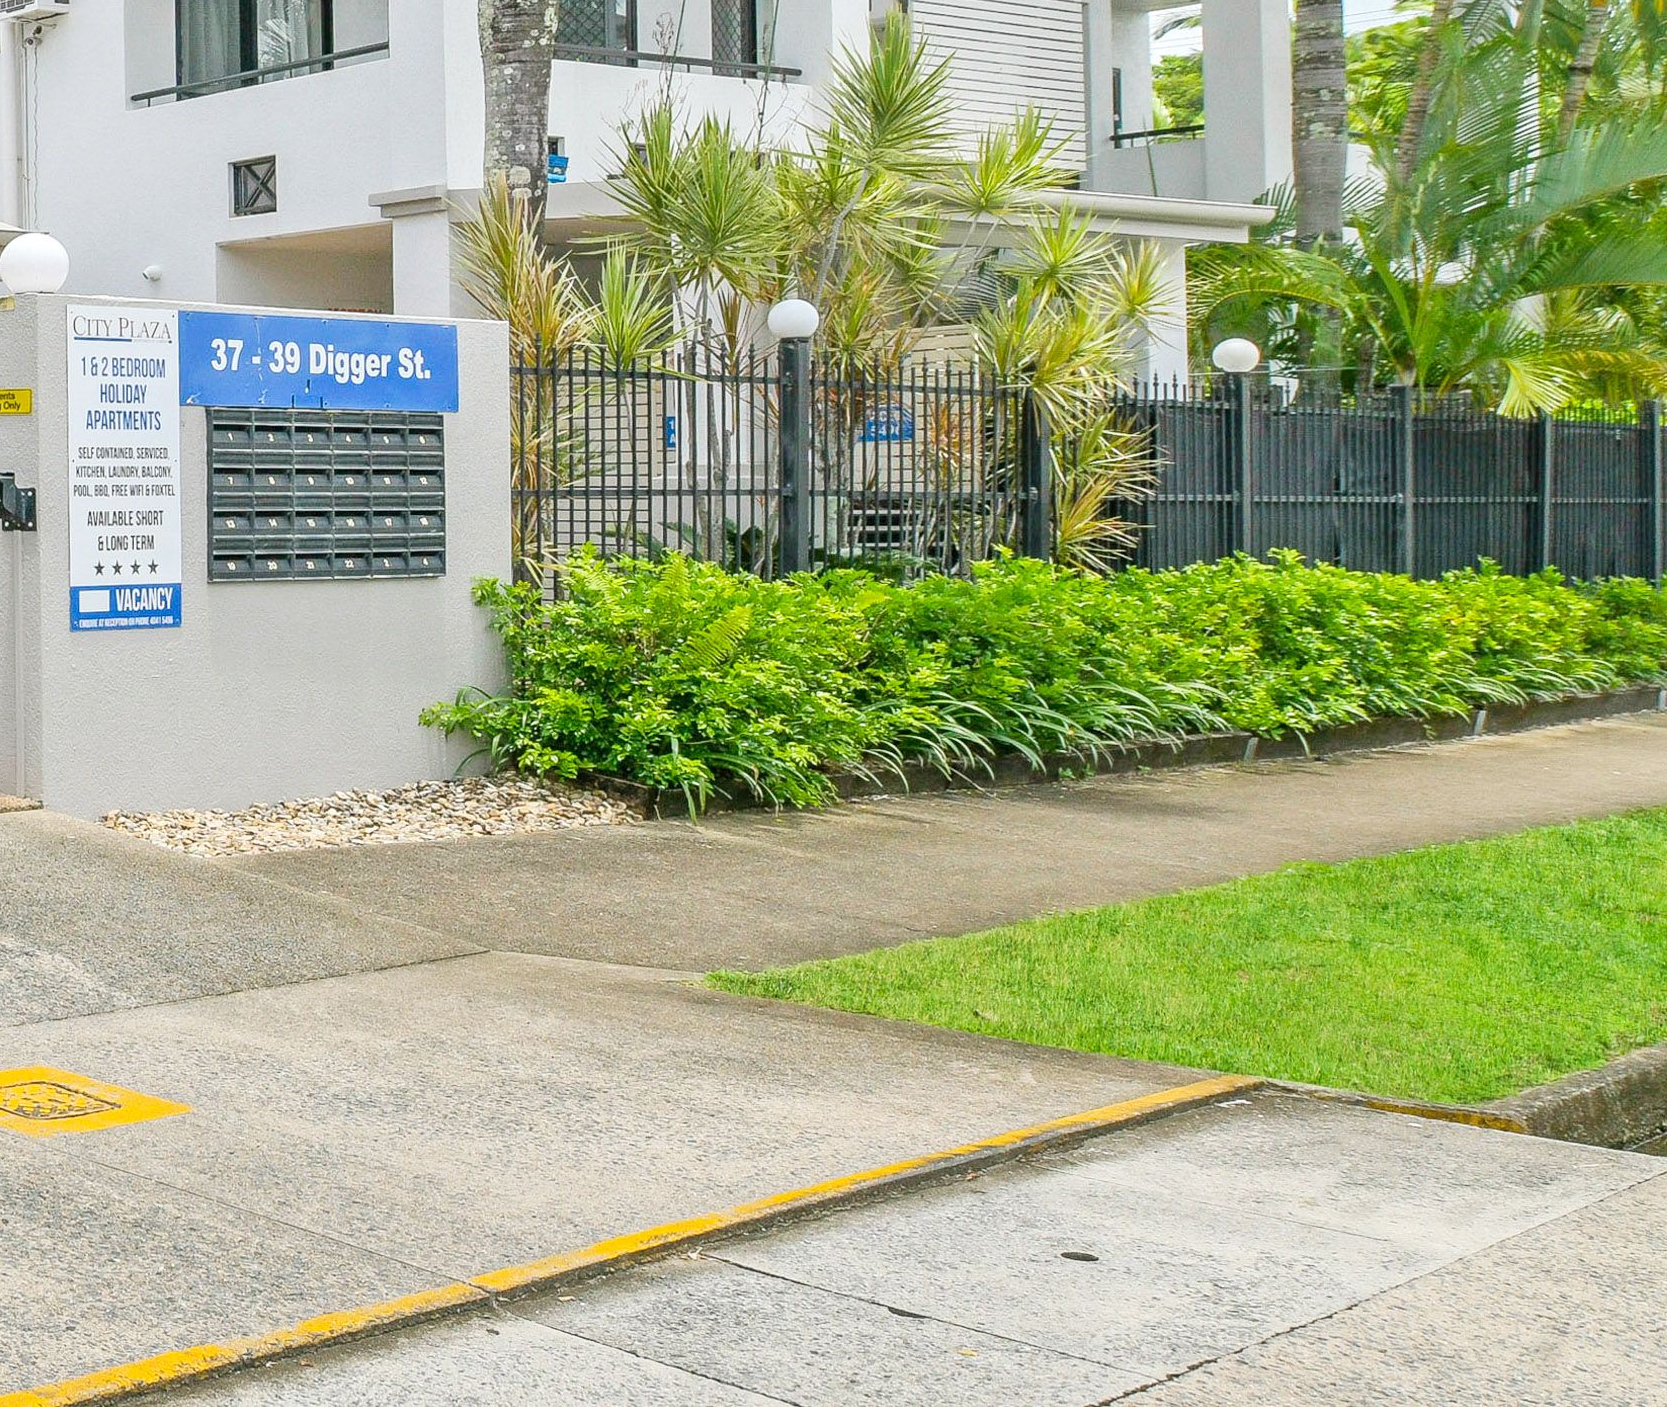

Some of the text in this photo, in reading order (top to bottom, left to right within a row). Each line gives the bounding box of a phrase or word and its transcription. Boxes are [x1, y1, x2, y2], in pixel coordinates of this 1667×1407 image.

[73, 315, 172, 340] CITY PLAZA
[210, 339, 431, 384] 37 - 39 Digger St.
[81, 356, 167, 379] 1 & 2 BEDROOM
[100, 383, 147, 404] HOLIDAY
[3, 401, 21, 411] Only
[86, 410, 162, 431] APARTMENTS
[227, 432, 235, 442] 1
[266, 434, 274, 443] 2
[306, 434, 314, 443] 3
[345, 434, 352, 443] 4
[78, 447, 95, 459] SELF
[227, 476, 234, 485] 7
[268, 476, 275, 485] 8
[308, 476, 315, 486] 9
[345, 477, 354, 485] 10
[383, 477, 391, 485] 11
[419, 477, 428, 486] 12
[111, 485, 129, 497] FREE
[151, 485, 176, 496] FOXTEL
[87, 510, 164, 527] AVAILABLE SHORT
[268, 519, 277, 528] 14
[306, 518, 316, 528] 15
[384, 518, 392, 527] 17
[226, 520, 235, 528] 13
[97, 535, 155, 551] & LONG TERM
[268, 561, 278, 570] 20
[345, 559, 354, 568] 22
[115, 587, 174, 612] VACANCY
